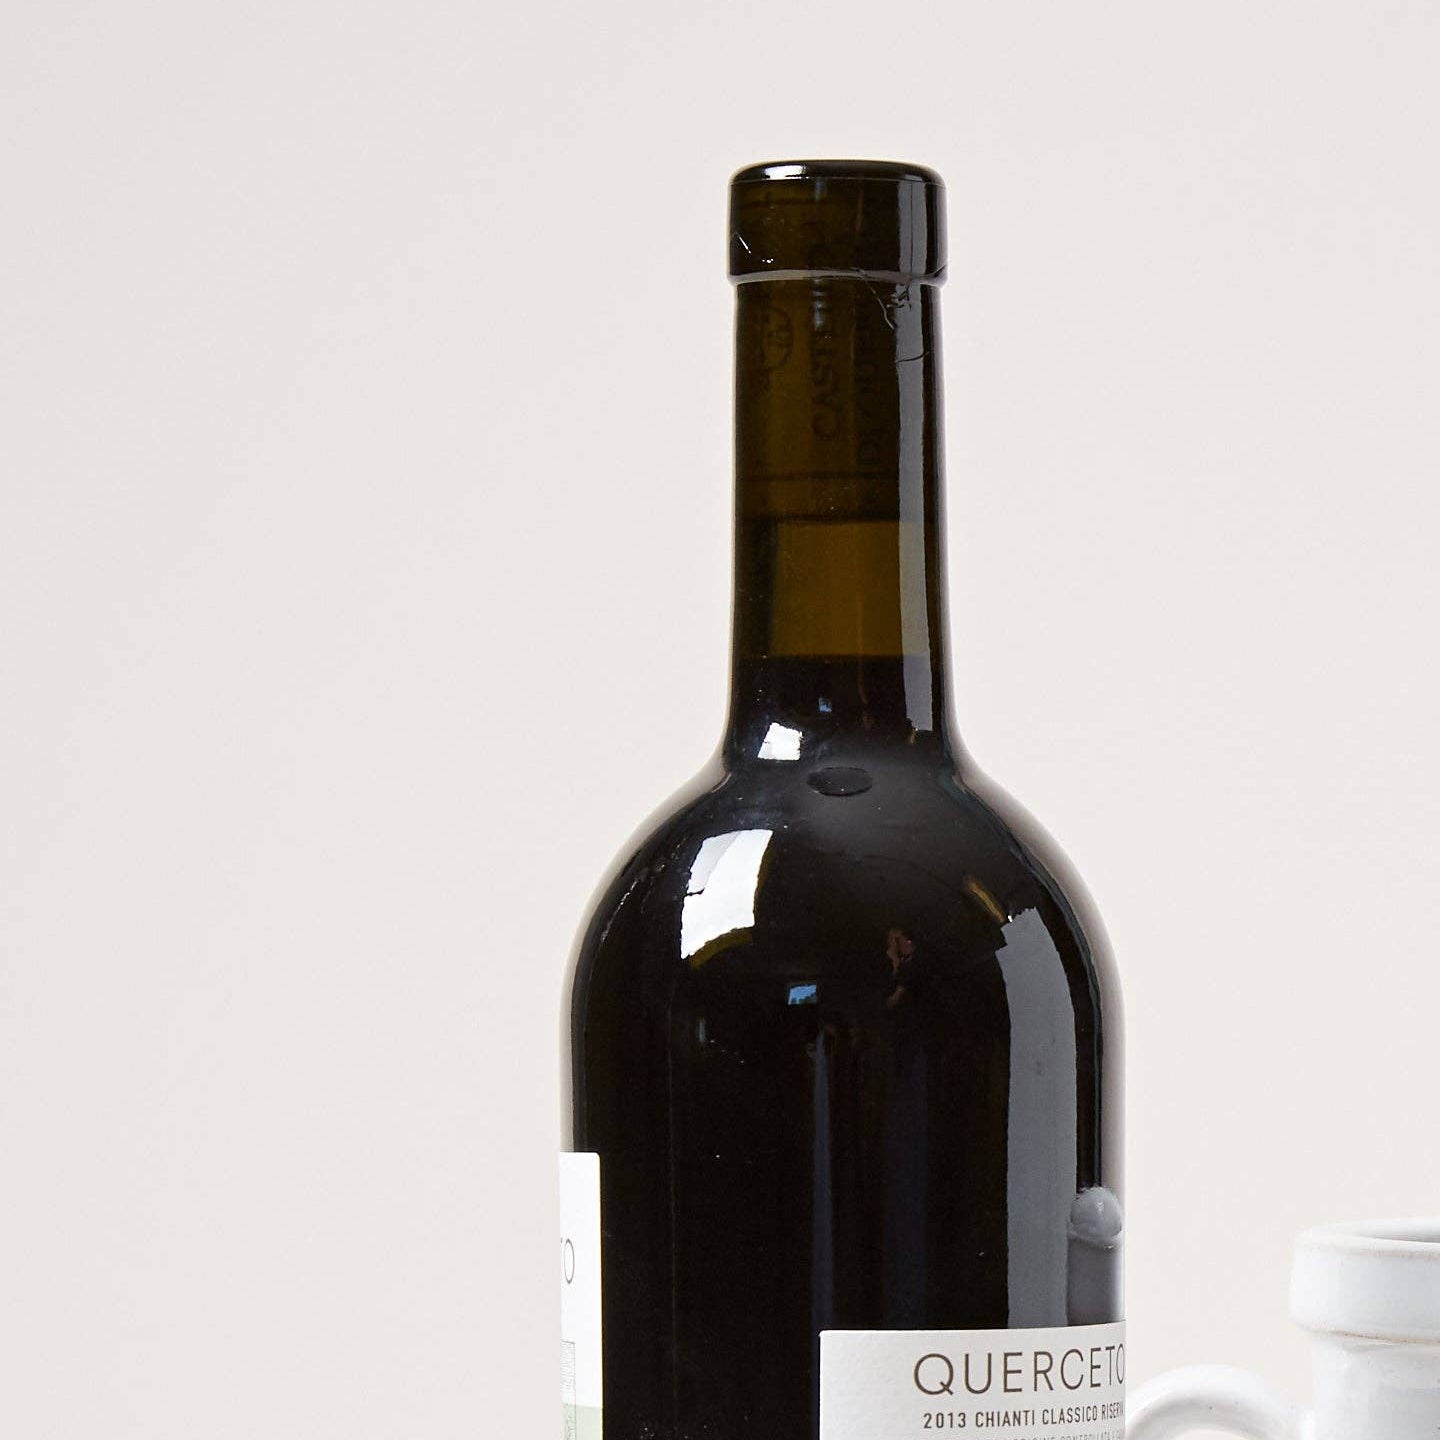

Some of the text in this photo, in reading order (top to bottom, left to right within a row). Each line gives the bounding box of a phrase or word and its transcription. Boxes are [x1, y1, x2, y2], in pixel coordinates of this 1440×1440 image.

[913, 1343, 1125, 1396] QUERCETO
[923, 1412, 967, 1429] 2013
[975, 1409, 1035, 1428] CHIANTI
[1042, 1404, 1098, 1425] CLASSICO
